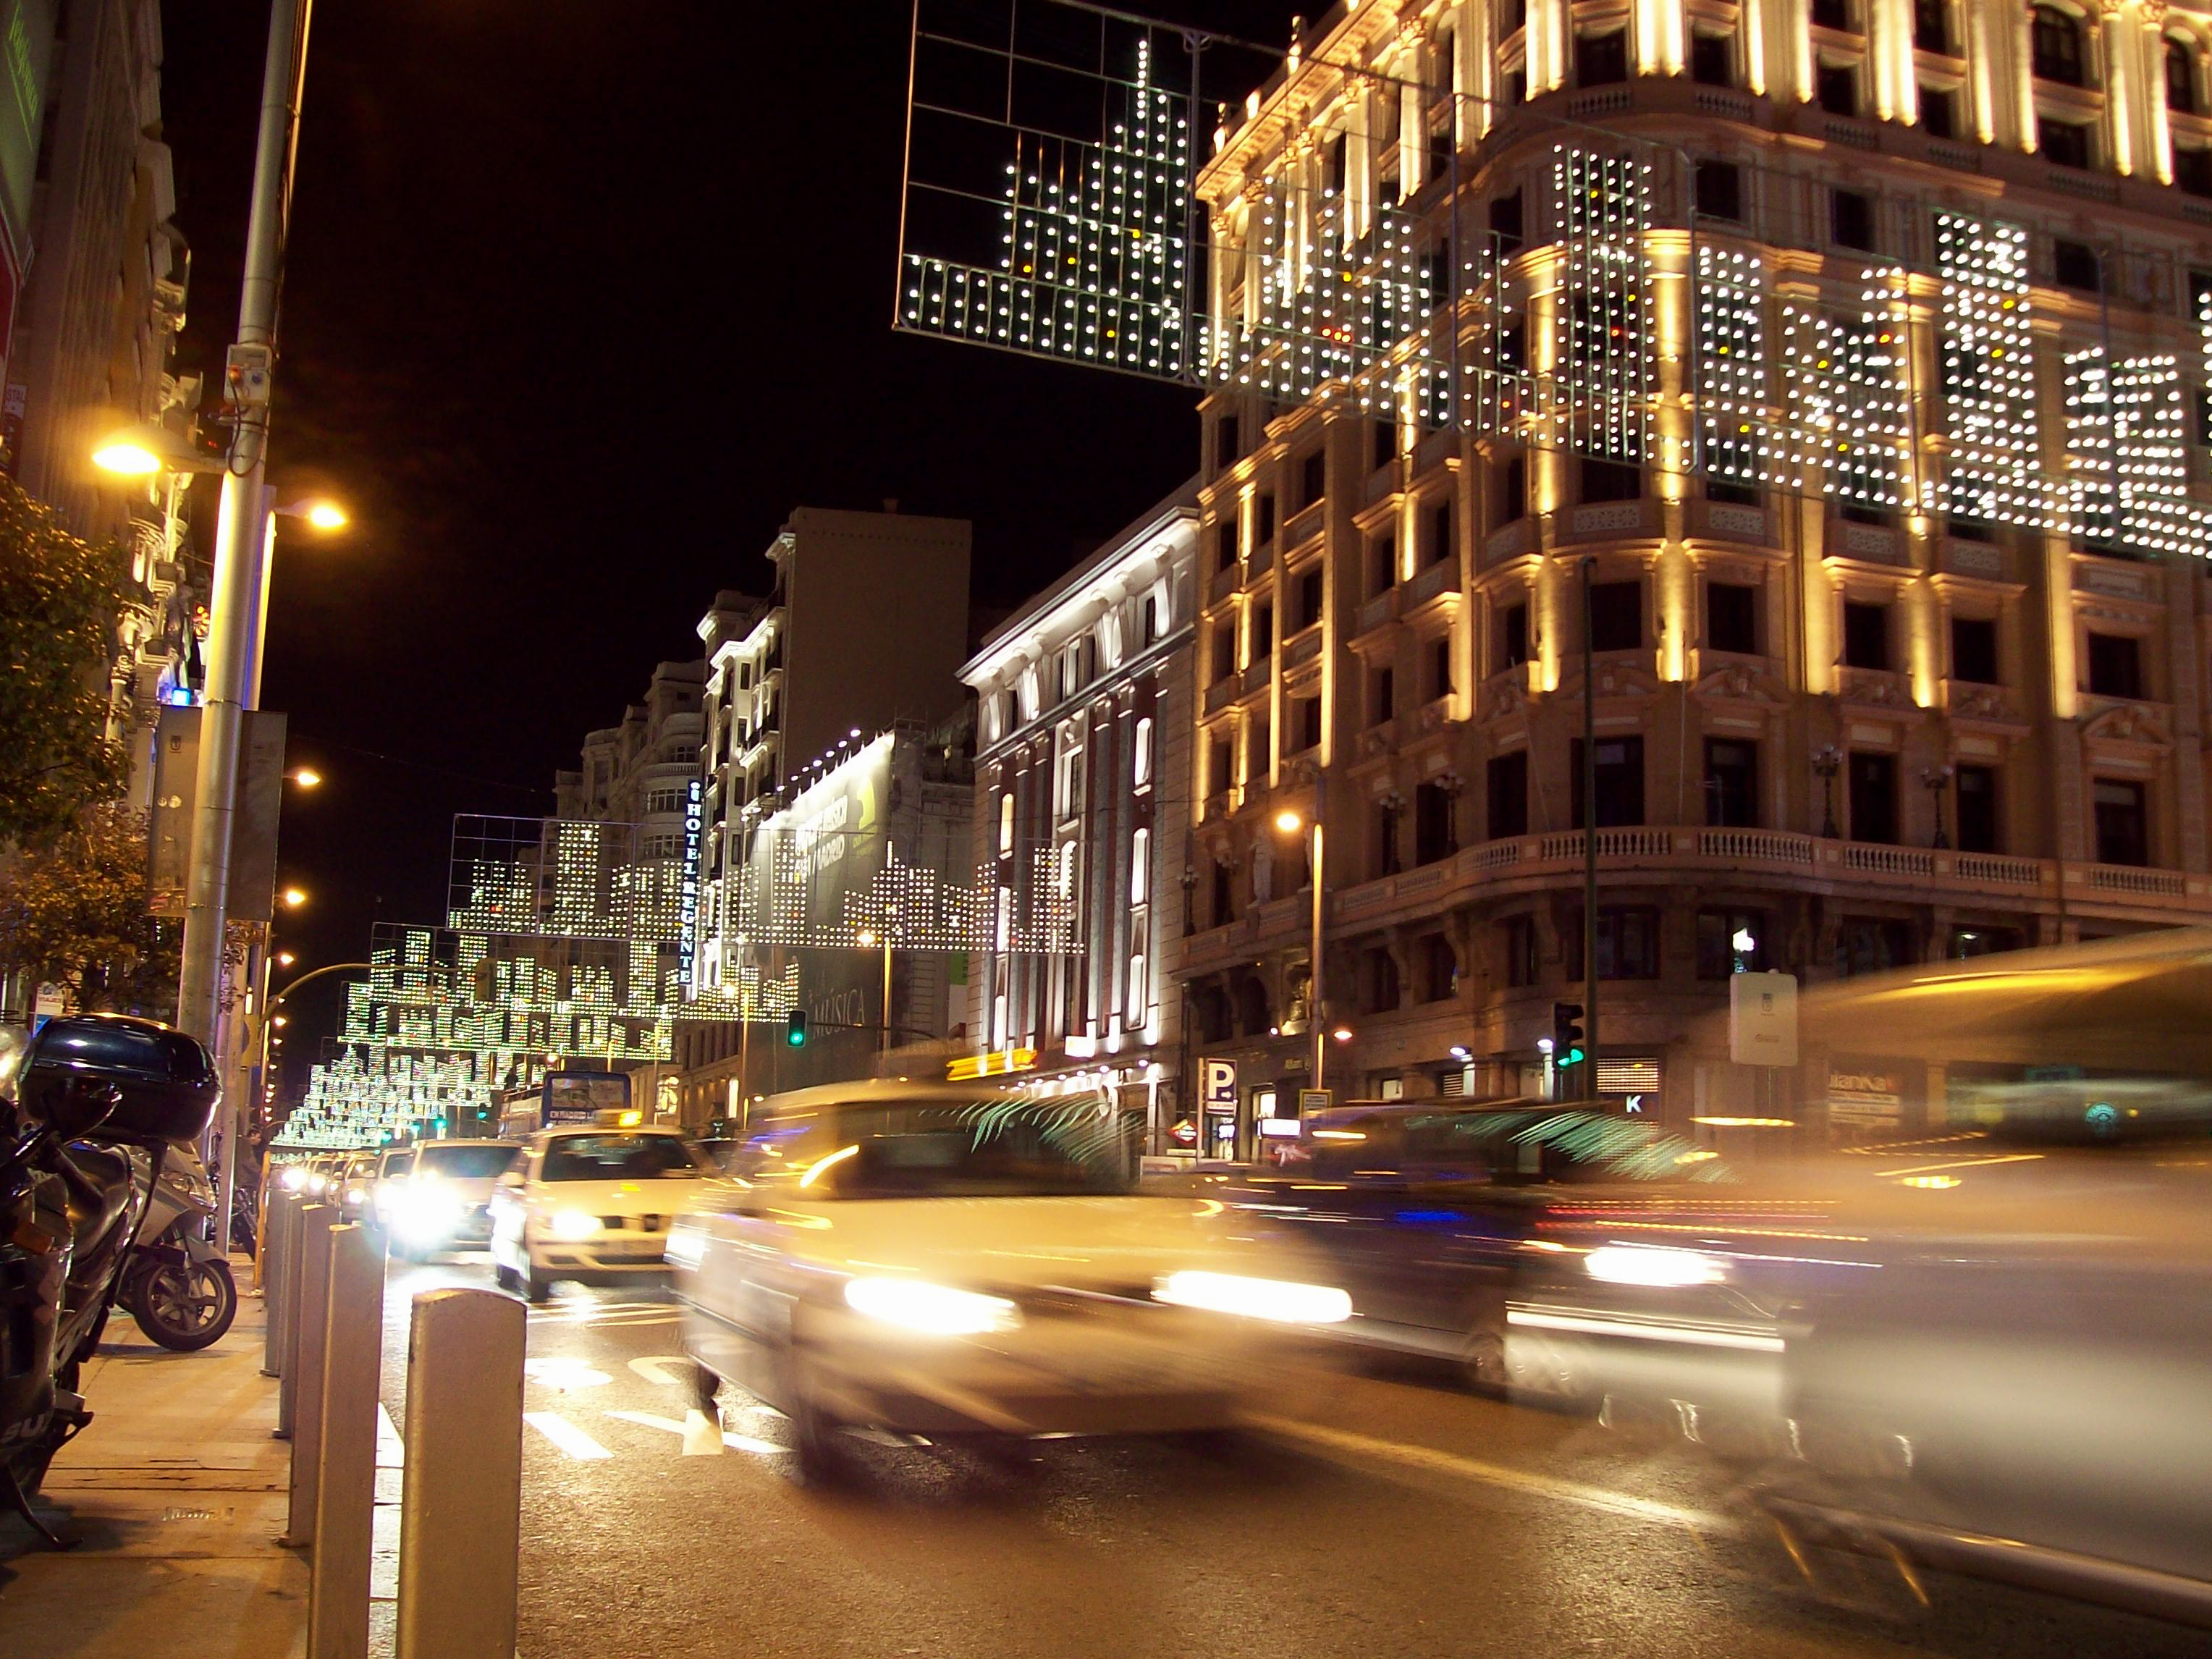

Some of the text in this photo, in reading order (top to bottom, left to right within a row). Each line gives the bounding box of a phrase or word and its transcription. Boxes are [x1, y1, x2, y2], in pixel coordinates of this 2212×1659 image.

[679, 803, 701, 983] HOTEL REGENTE
[813, 987, 865, 1039] MÚSICA
[1208, 1063, 1235, 1099] P
[1626, 1094, 1643, 1113] K
